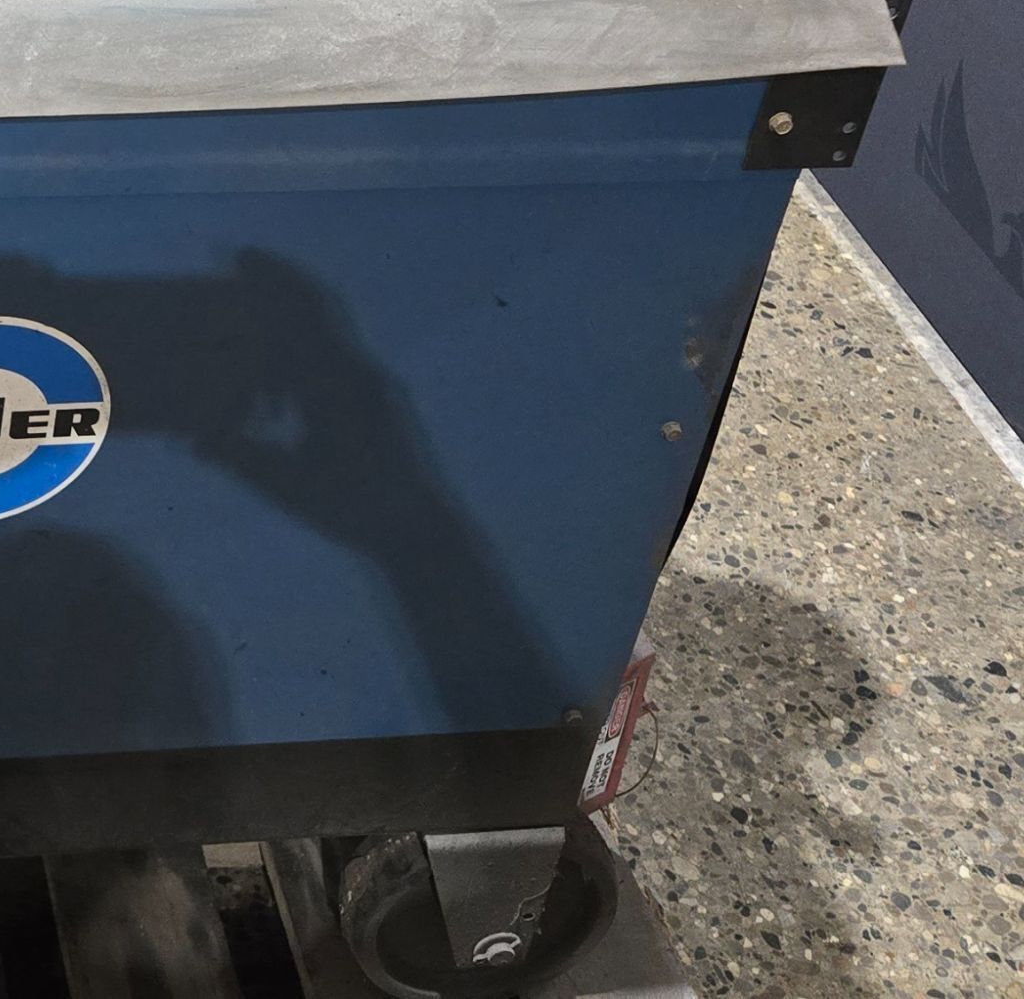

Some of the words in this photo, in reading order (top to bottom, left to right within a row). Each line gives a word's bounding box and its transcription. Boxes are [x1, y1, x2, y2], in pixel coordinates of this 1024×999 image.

[603, 749, 615, 767] DO
[585, 753, 605, 797] REMOVE
[596, 766, 610, 788] NOT
